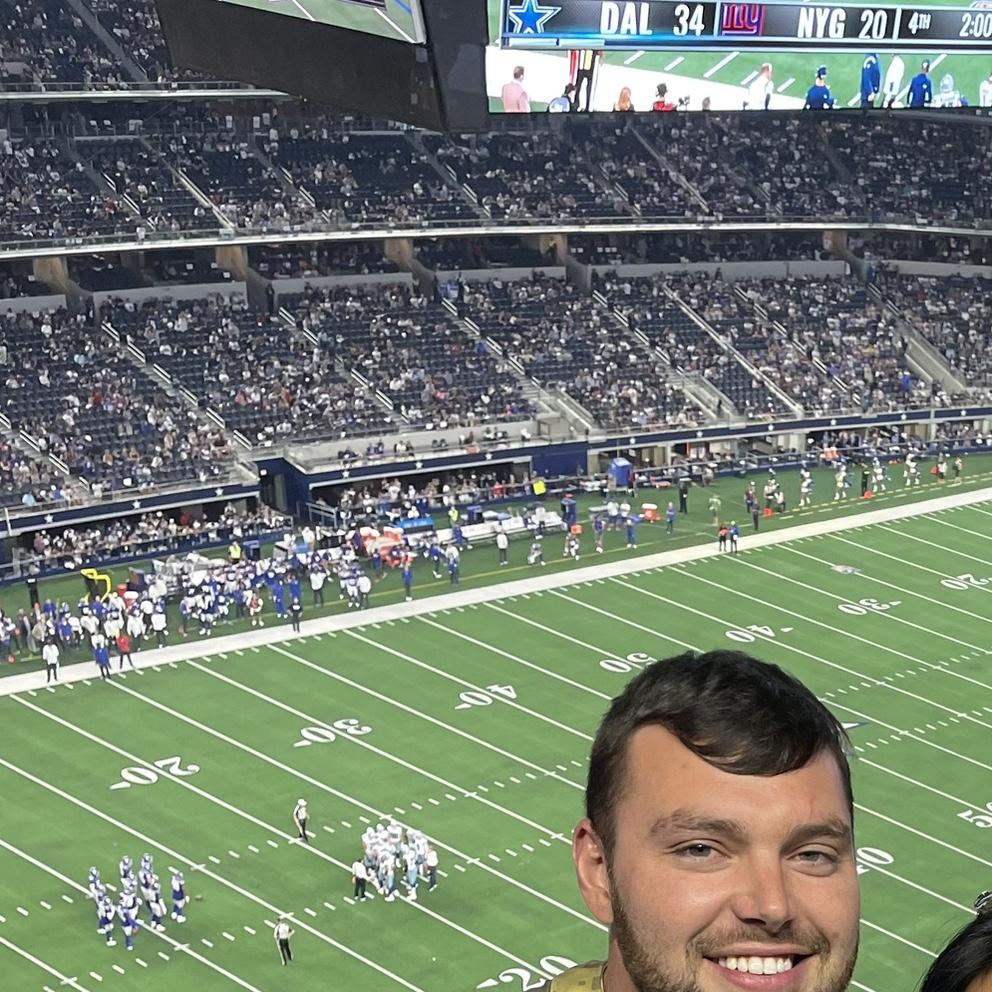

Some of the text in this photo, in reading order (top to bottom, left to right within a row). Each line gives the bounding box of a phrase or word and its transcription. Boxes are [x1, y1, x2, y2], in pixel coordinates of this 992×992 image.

[601, 2, 704, 36] DAL 34
[797, 8, 887, 39] NYG 20
[908, 12, 931, 34] 4TH
[940, 573, 989, 590] 20
[837, 598, 890, 616] 30
[725, 624, 776, 643] 40
[459, 684, 517, 706] 40
[300, 718, 372, 744] 30
[120, 755, 200, 785] 20
